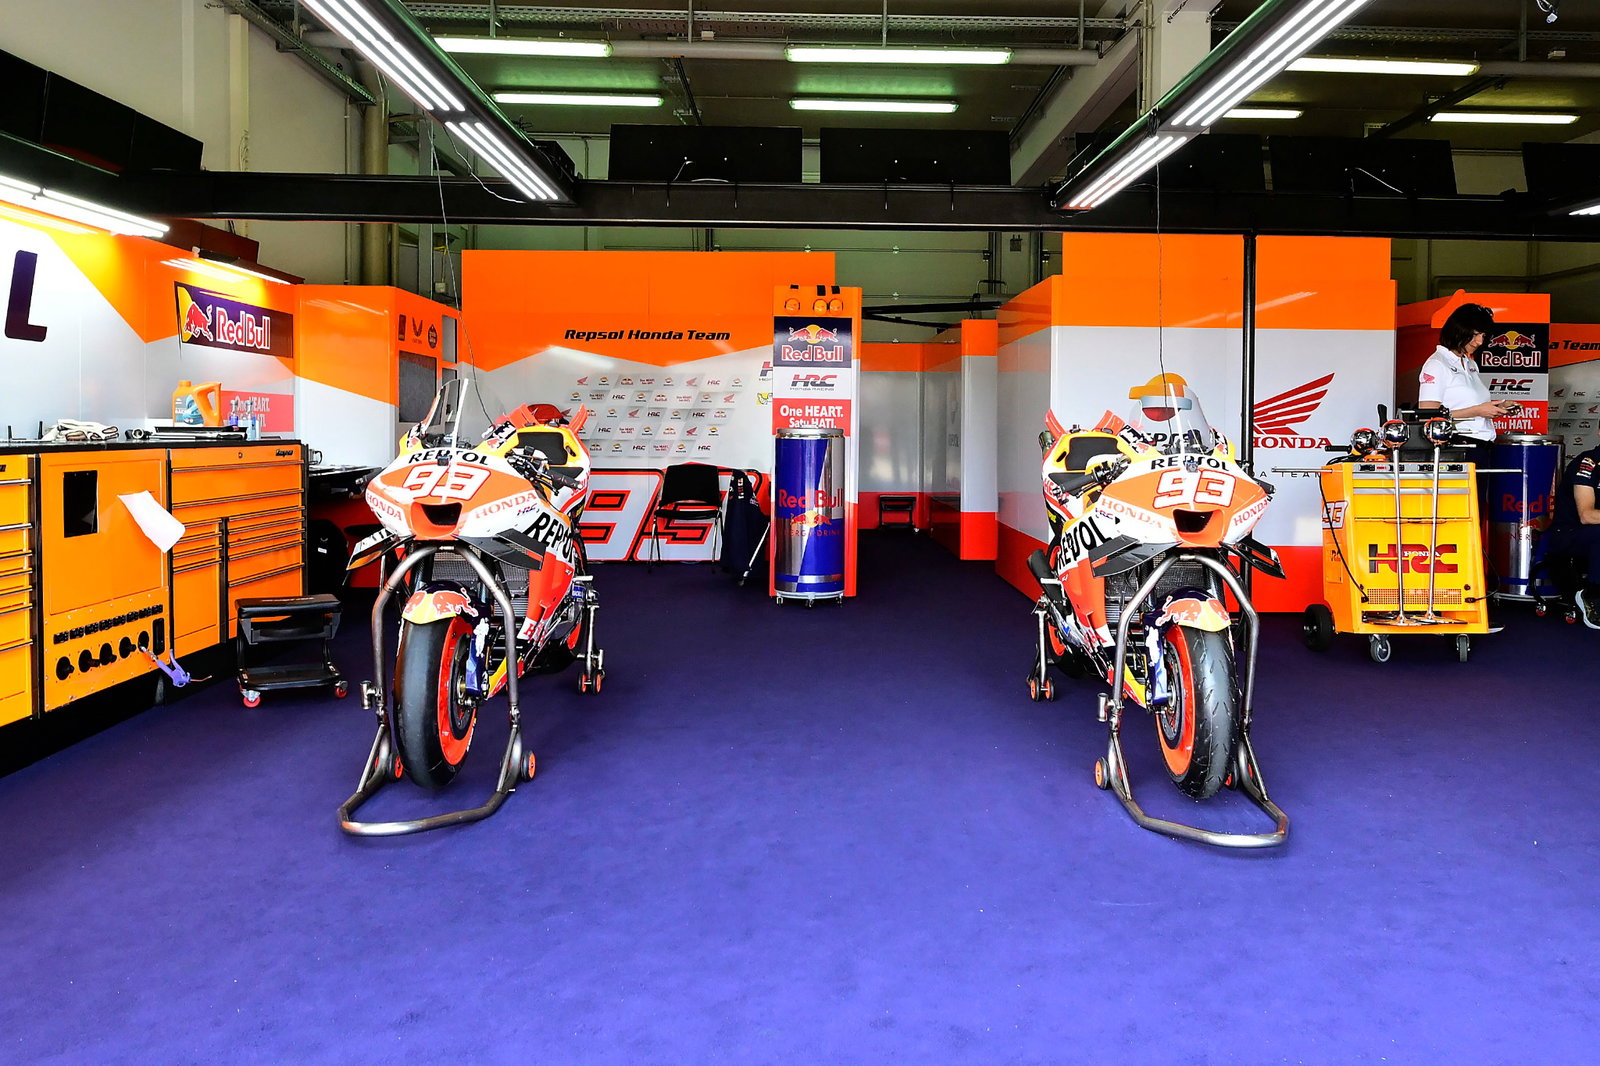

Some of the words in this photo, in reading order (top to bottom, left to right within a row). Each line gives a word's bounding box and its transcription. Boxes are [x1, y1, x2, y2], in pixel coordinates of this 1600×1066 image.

[4, 249, 48, 342] L
[216, 306, 246, 346] Red
[245, 313, 271, 350] Bull
[564, 329, 625, 342] Repsol
[627, 329, 684, 340] Honda
[687, 329, 731, 341] Team
[781, 344, 813, 361] Red
[814, 345, 844, 362] Bull
[1481, 350, 1512, 367] Red
[1512, 350, 1542, 367] Bull
[791, 374, 838, 387] HRC
[1488, 378, 1534, 391] HRC
[780, 405, 803, 416] One
[805, 405, 844, 417] HEART.
[789, 417, 810, 428] Satu
[811, 418, 837, 429] HATI.
[1493, 420, 1507, 429] atu
[1508, 420, 1534, 430] HATI.
[1253, 437, 1332, 448] HONDA
[402, 462, 492, 501] 93
[1152, 468, 1236, 509] 93
[366, 492, 402, 521] HONDA
[475, 491, 537, 519] HONDA
[778, 488, 811, 508] Red
[814, 488, 843, 508] Bull
[1502, 494, 1543, 513] Red
[1101, 497, 1163, 529] HONDA
[1322, 500, 1349, 530] 93
[1368, 543, 1459, 574] HRC
